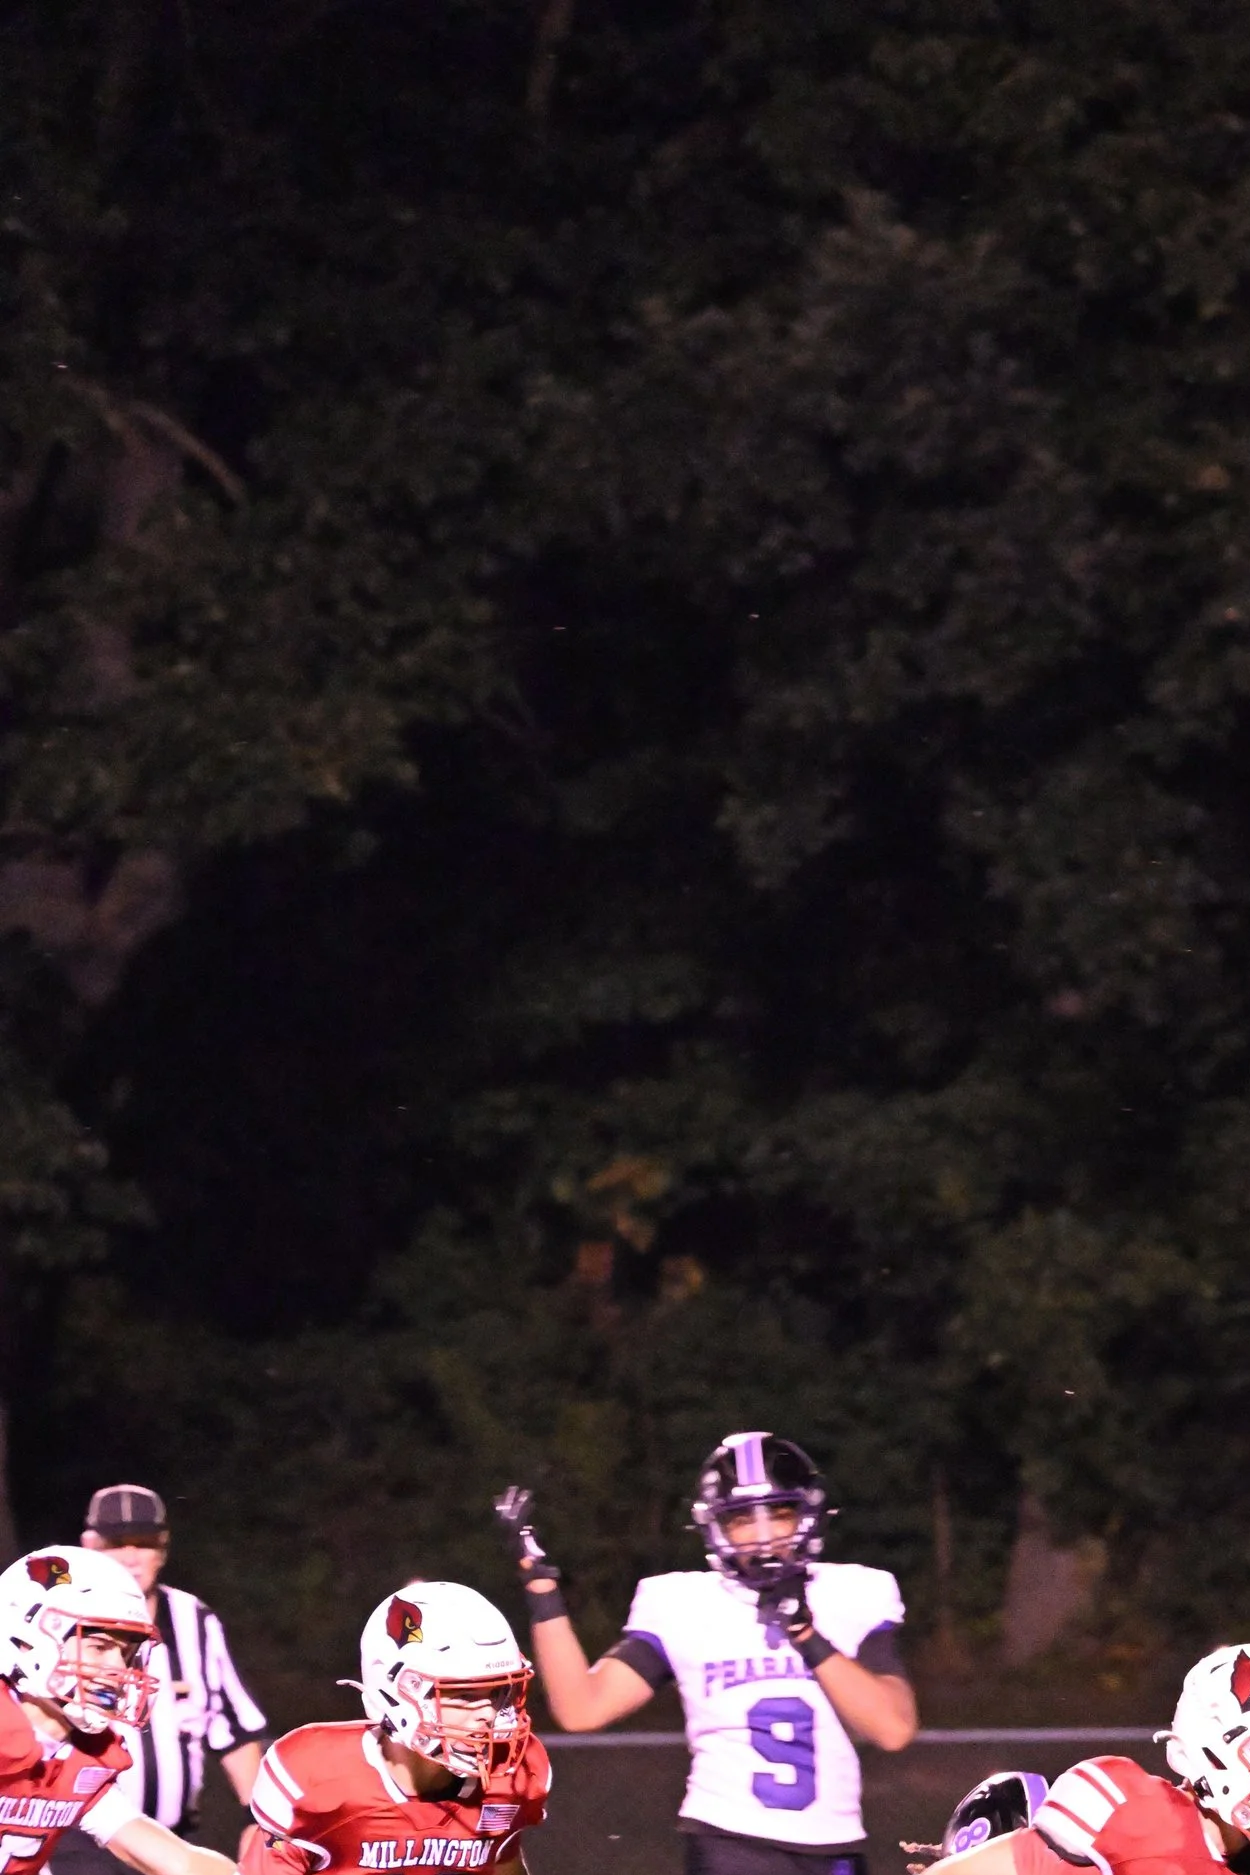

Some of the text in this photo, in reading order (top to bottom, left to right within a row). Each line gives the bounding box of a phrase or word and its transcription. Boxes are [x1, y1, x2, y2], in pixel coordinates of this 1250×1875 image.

[747, 1696, 816, 1811] 9
[358, 1837, 495, 1869] MILLINGTON
[953, 1816, 992, 1854] 8
